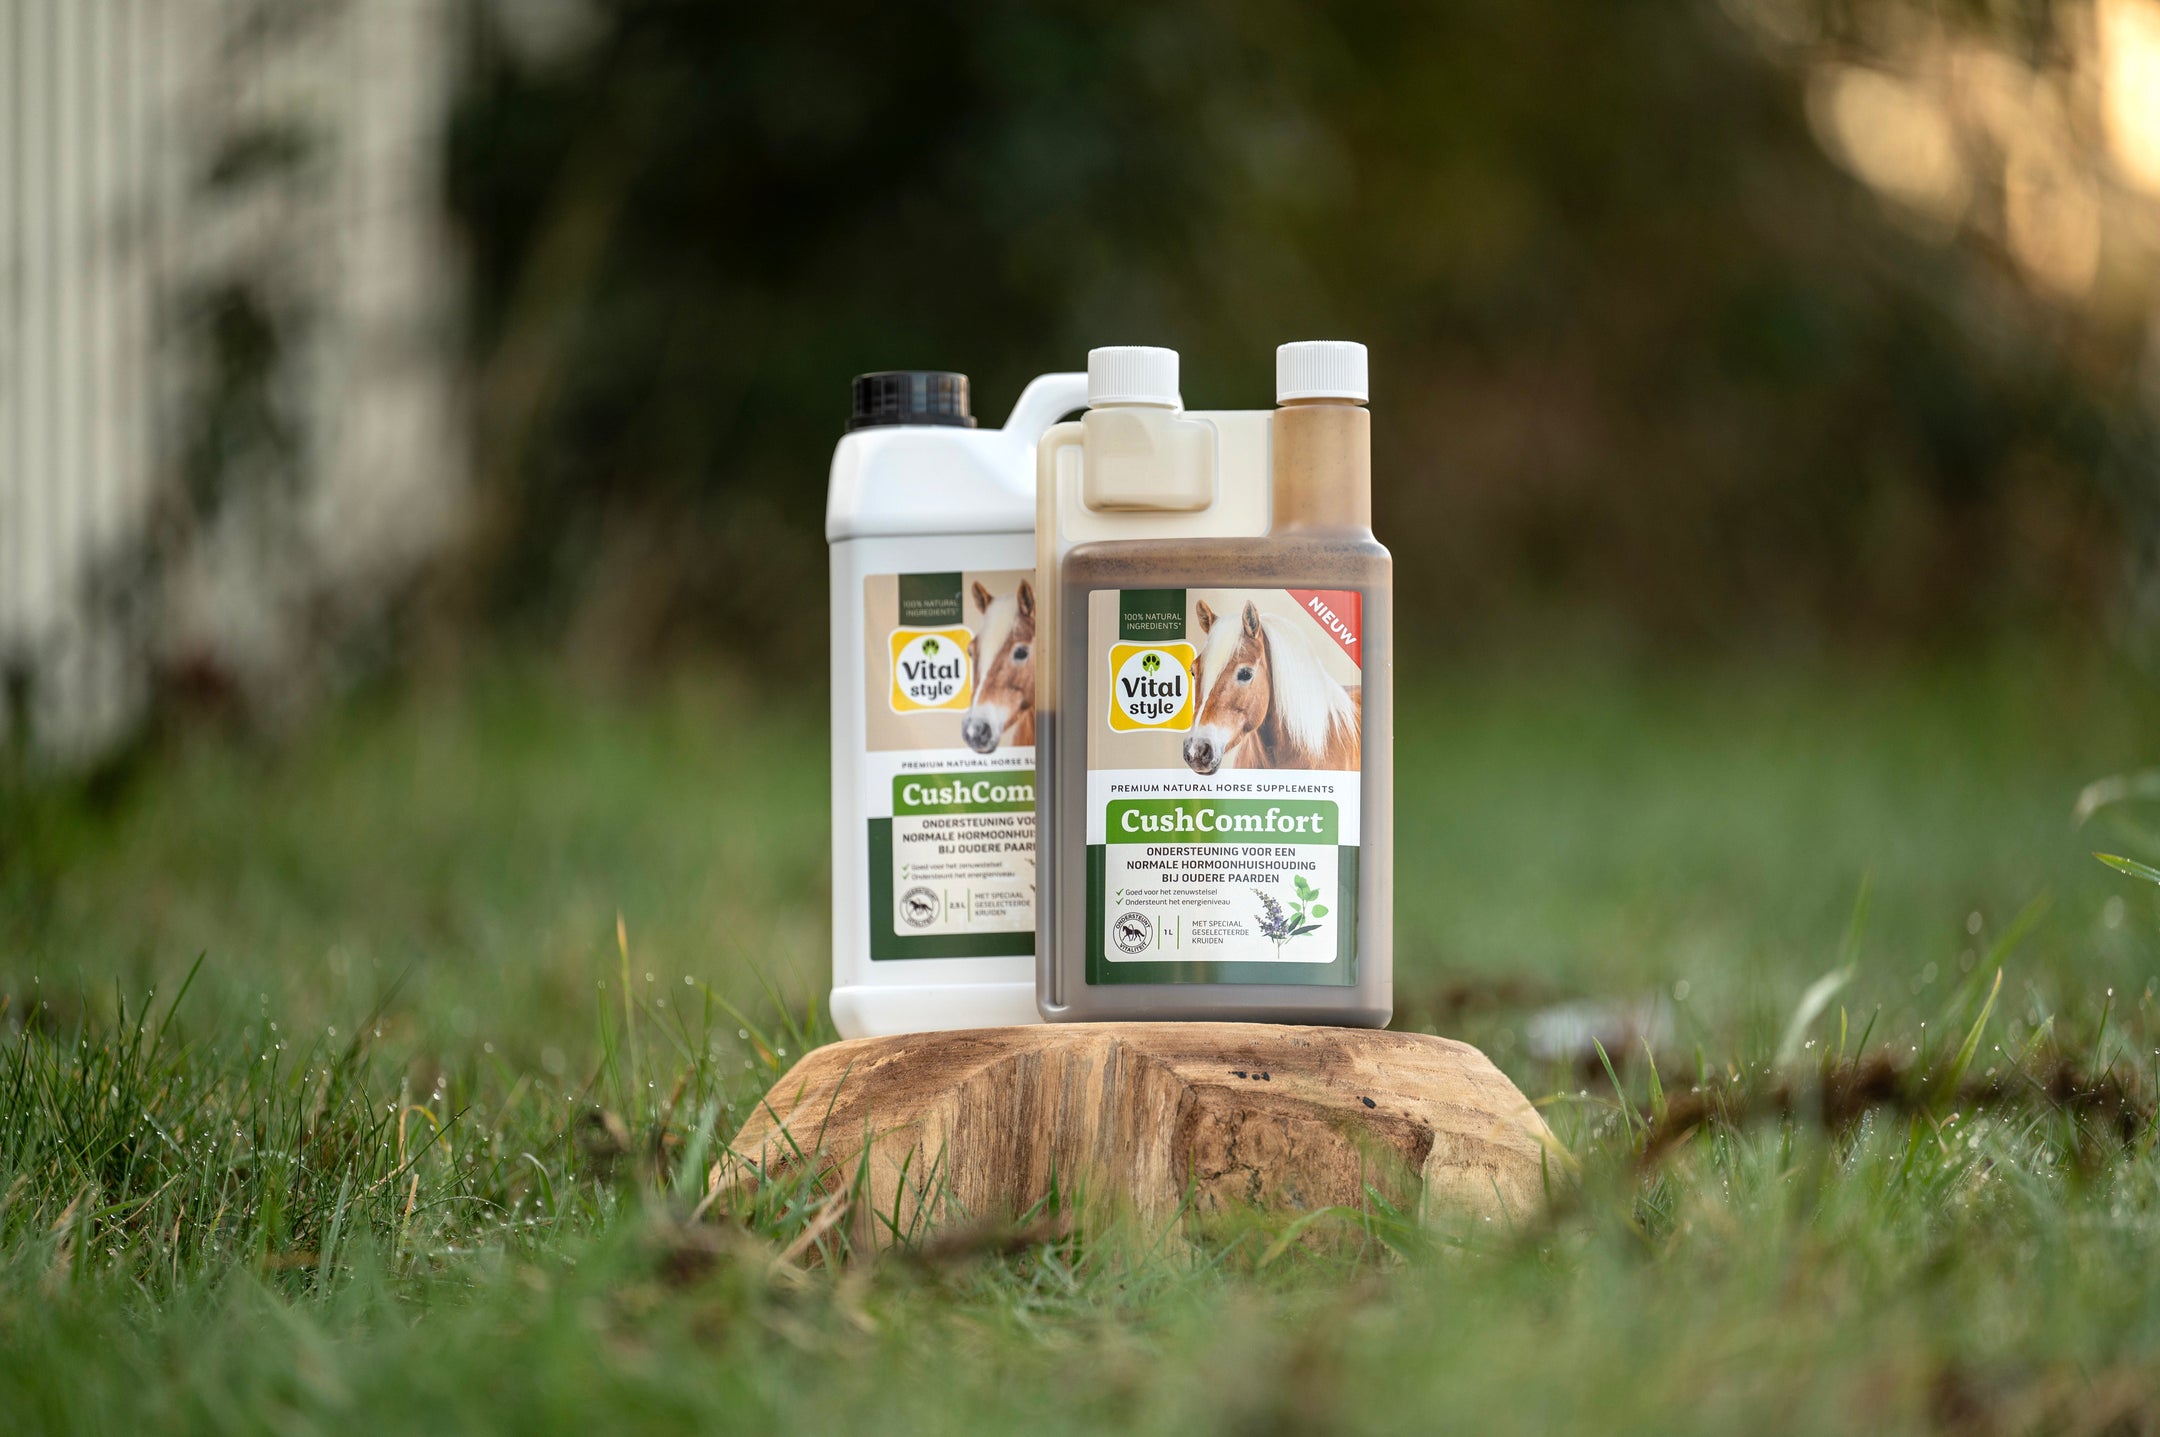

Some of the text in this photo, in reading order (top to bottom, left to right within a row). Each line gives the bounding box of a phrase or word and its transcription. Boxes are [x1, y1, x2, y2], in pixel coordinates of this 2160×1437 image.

[923, 599, 959, 607] NATURAL
[1308, 596, 1357, 646] NIEUW
[902, 658, 960, 680] Vital
[910, 682, 953, 700] style
[1121, 675, 1182, 698] Vital
[1129, 698, 1174, 719] style
[901, 761, 944, 769] PREMIUM
[946, 759, 988, 768] NATURAL
[991, 757, 1021, 765] HORSE
[902, 780, 1036, 806] CushCom
[1111, 784, 1334, 793] PREMIUM NATURAL HORSE SUPPLEMENTS
[922, 817, 1014, 829] ONDERSTEUNING
[1121, 807, 1324, 833] CushComfort
[902, 830, 1036, 843] NORMALE HORMOONHUI
[938, 841, 1036, 854] BIJ OUDERE PAAR
[1146, 847, 1296, 857] ONDERSTEUNING VOOR EEN
[1126, 860, 1317, 871] NORMALE HORMOONHUISHOUDING
[1162, 873, 1280, 884] BIJ OUDERE PAARDEN
[1160, 888, 1171, 896] het
[1173, 888, 1218, 896] zenuwstelsel
[1125, 898, 1167, 906] Ondersteunt
[1116, 913, 1151, 930] ONDERSTEUNT
[1192, 920, 1243, 928] MET SPECIAAL
[1119, 941, 1148, 953] VITALITEIT
